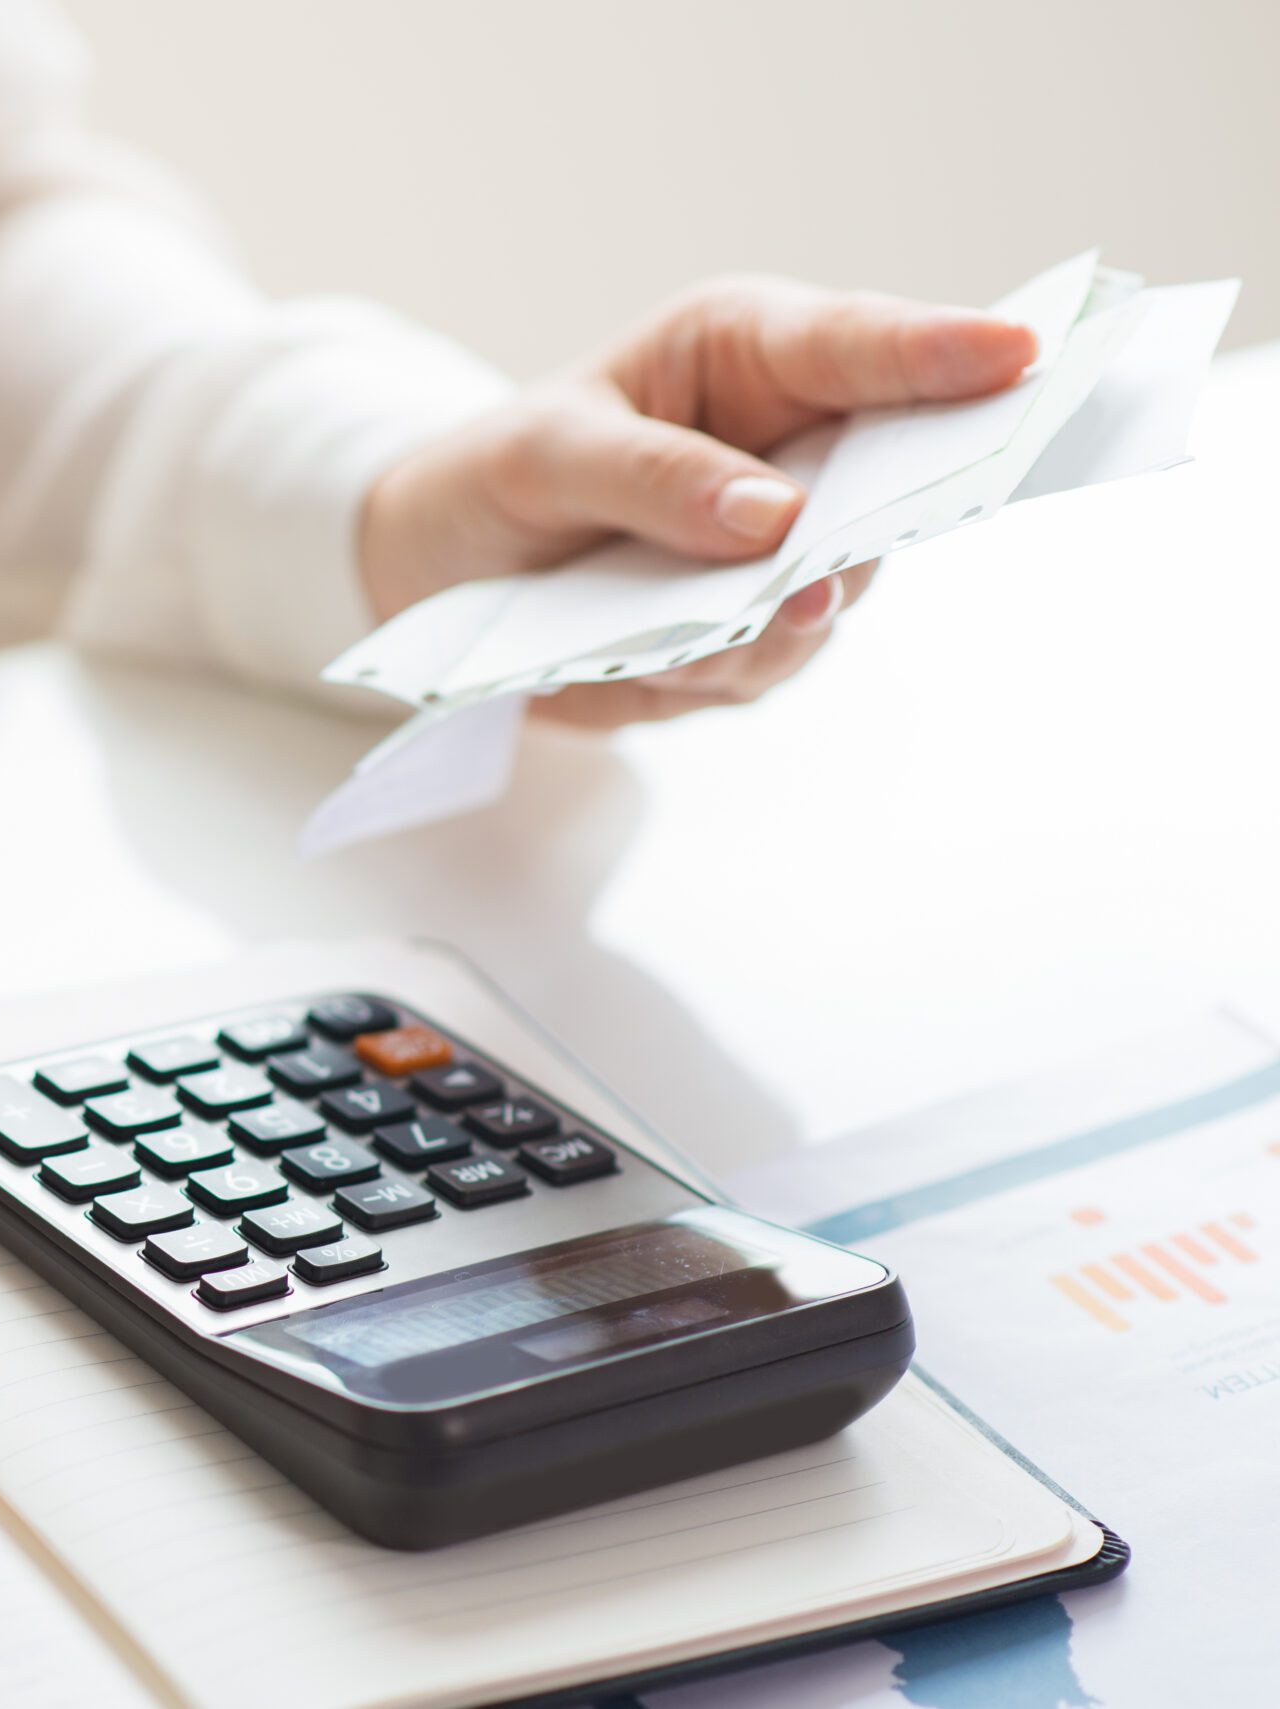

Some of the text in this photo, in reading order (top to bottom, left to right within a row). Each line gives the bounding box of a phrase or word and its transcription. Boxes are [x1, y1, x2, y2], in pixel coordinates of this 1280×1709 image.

[297, 1054, 331, 1079] 1
[213, 1074, 245, 1096] 2
[113, 1096, 154, 1119] 3
[346, 1088, 382, 1112] 4
[1, 1104, 33, 1121] +
[257, 1109, 297, 1135] 5
[163, 1131, 200, 1155] 6
[409, 1122, 448, 1150] 7
[308, 1147, 351, 1171] 8
[540, 1137, 593, 1163] MC
[223, 1168, 260, 1192] 9
[449, 1160, 506, 1184] MR
[268, 1206, 323, 1230] M+
[321, 1245, 358, 1262] %
[222, 1265, 270, 1287] MU
